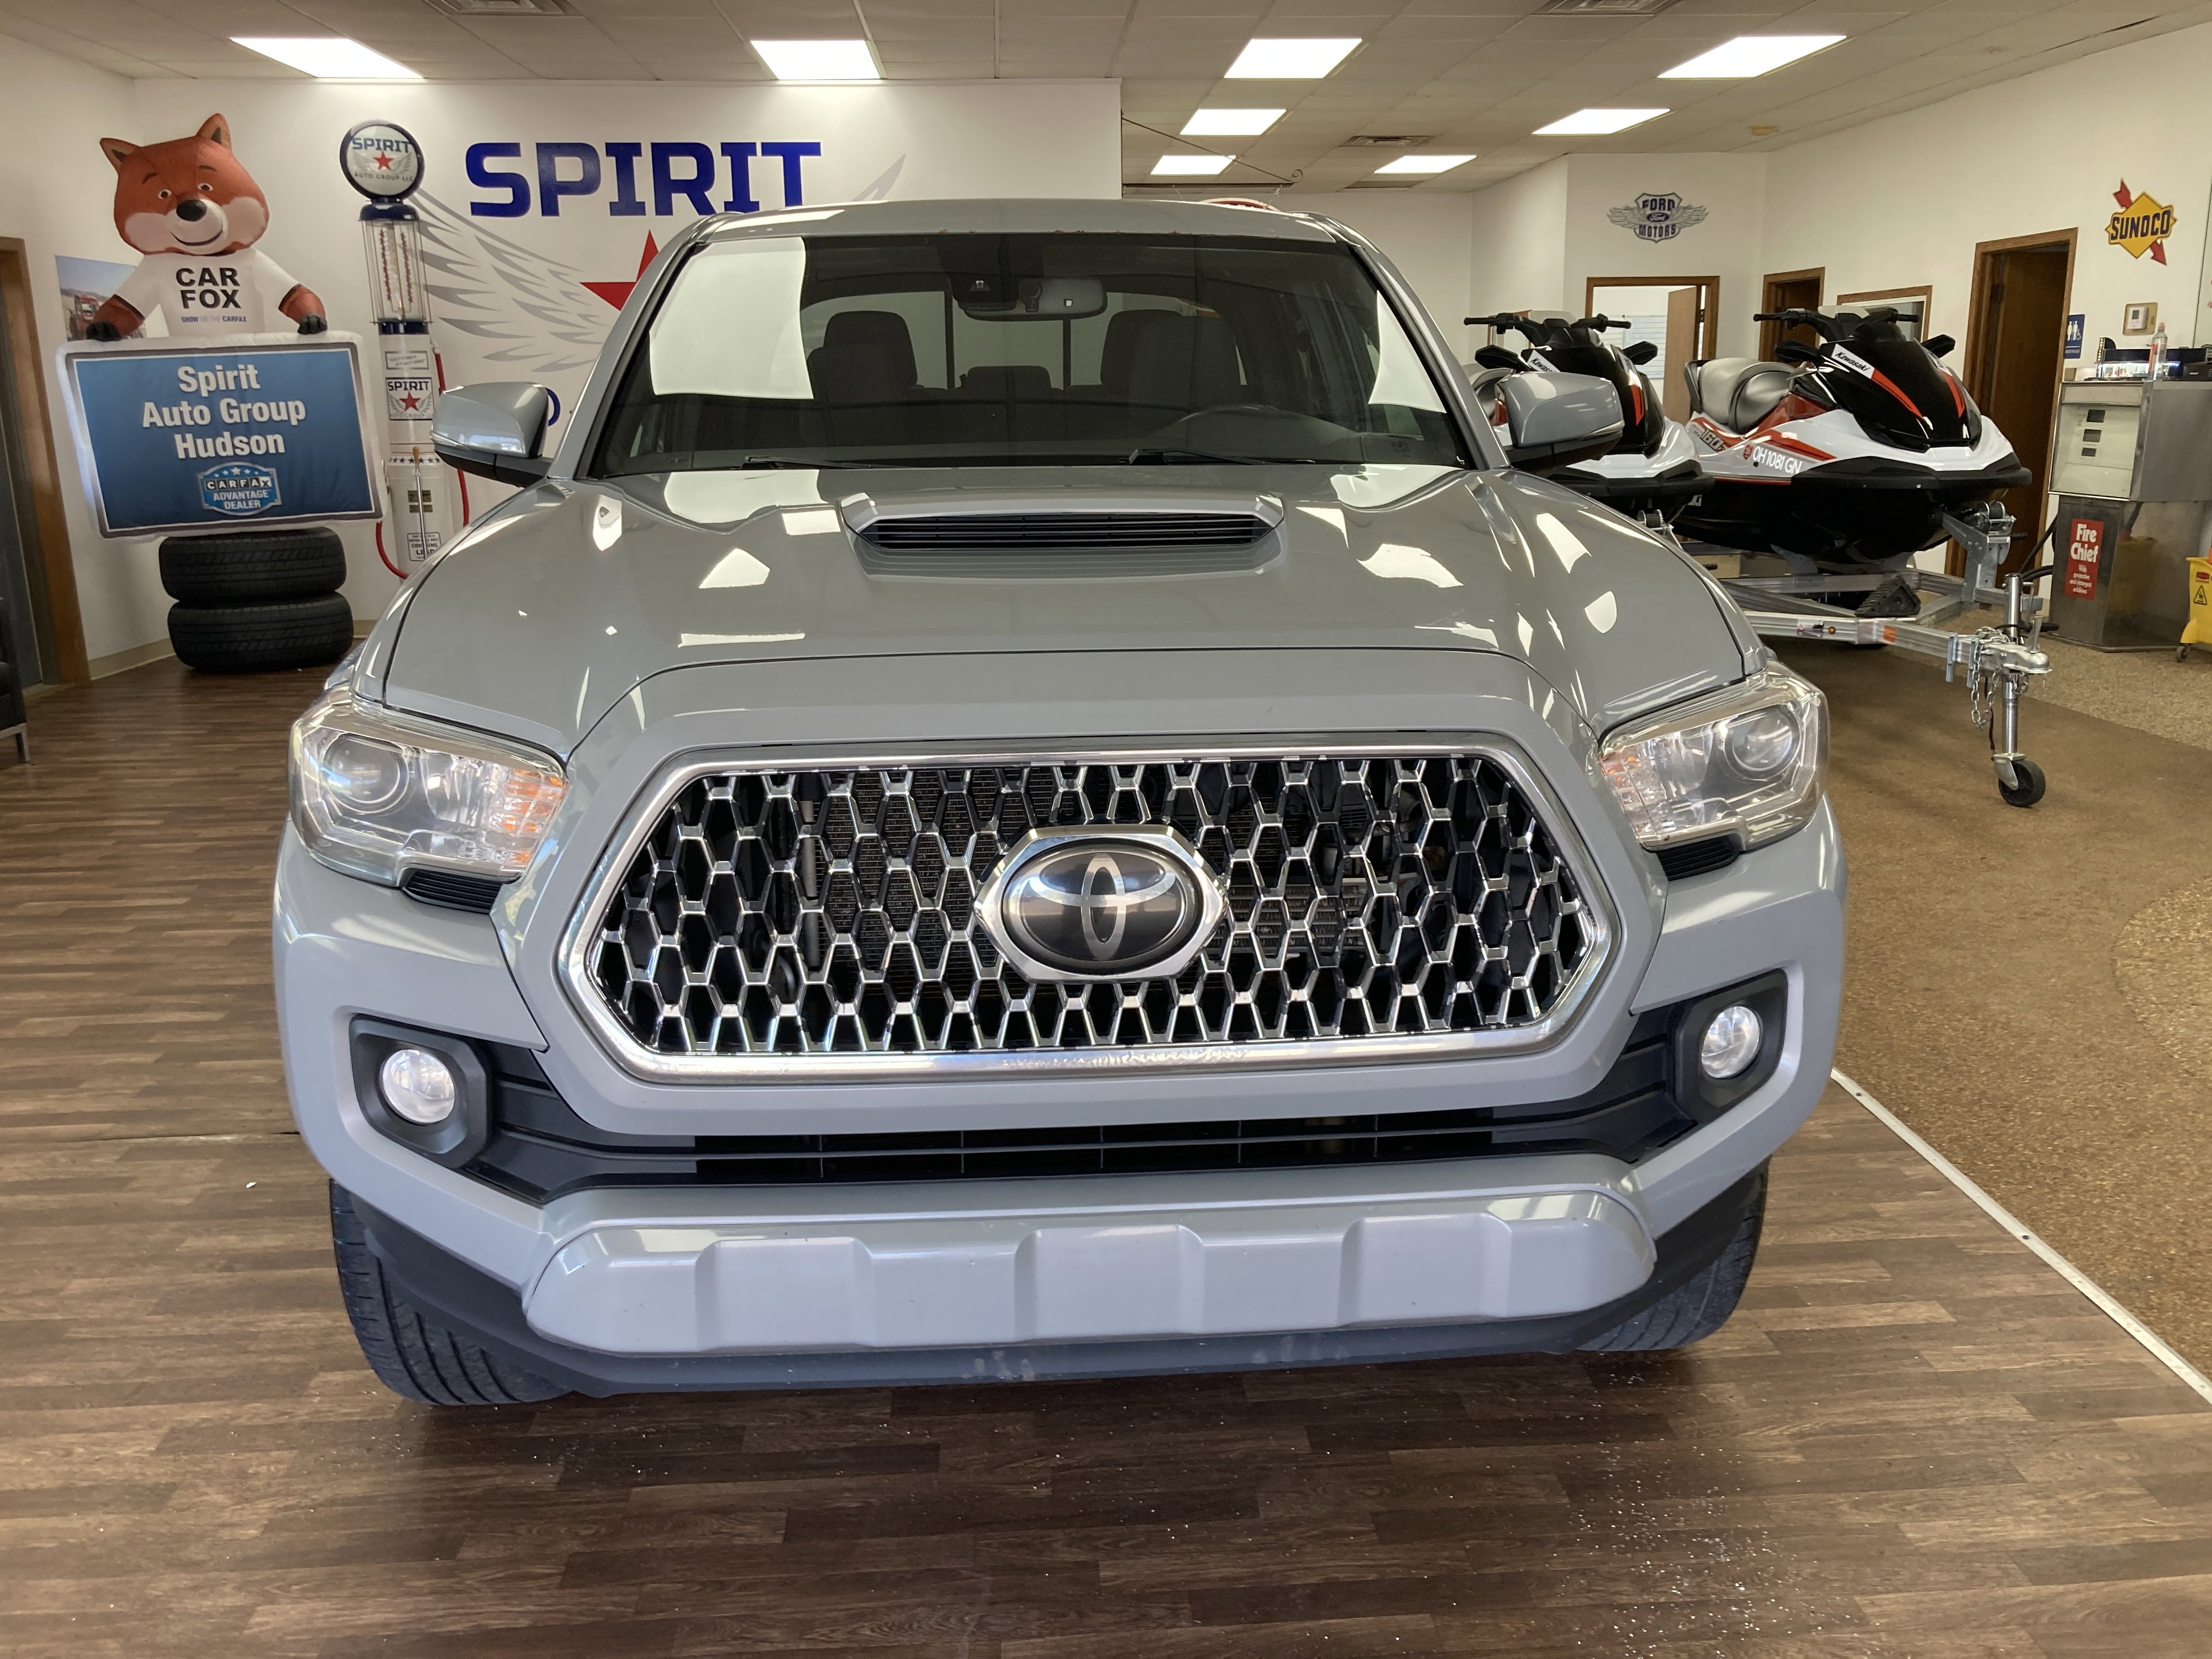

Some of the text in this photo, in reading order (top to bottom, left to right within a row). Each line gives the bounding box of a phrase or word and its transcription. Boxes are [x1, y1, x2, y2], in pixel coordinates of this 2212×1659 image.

[352, 137, 411, 153] SPIRIT
[465, 141, 821, 217] SPIRIT
[1642, 198, 1675, 211] FORD
[1639, 223, 1676, 238] MOTORS
[2111, 210, 2171, 240] SUNOCO
[176, 268, 240, 287] CAR
[180, 289, 241, 309] FOX
[1530, 358, 1556, 373] Kawas
[1835, 352, 1871, 371] Kawasaki
[177, 364, 261, 397] Spirit
[388, 381, 429, 391] SPIRIT
[143, 398, 306, 428] Auto Group
[174, 431, 285, 459] Hudson
[1753, 446, 1768, 464] OH
[1767, 451, 1785, 470] 1081
[1785, 458, 1803, 475] GN
[206, 476, 271, 490] CARFAX
[213, 490, 269, 501] ADVANTAGE
[224, 500, 261, 510] DEALER
[2076, 523, 2097, 543] Fire
[2070, 542, 2099, 563] Chief
